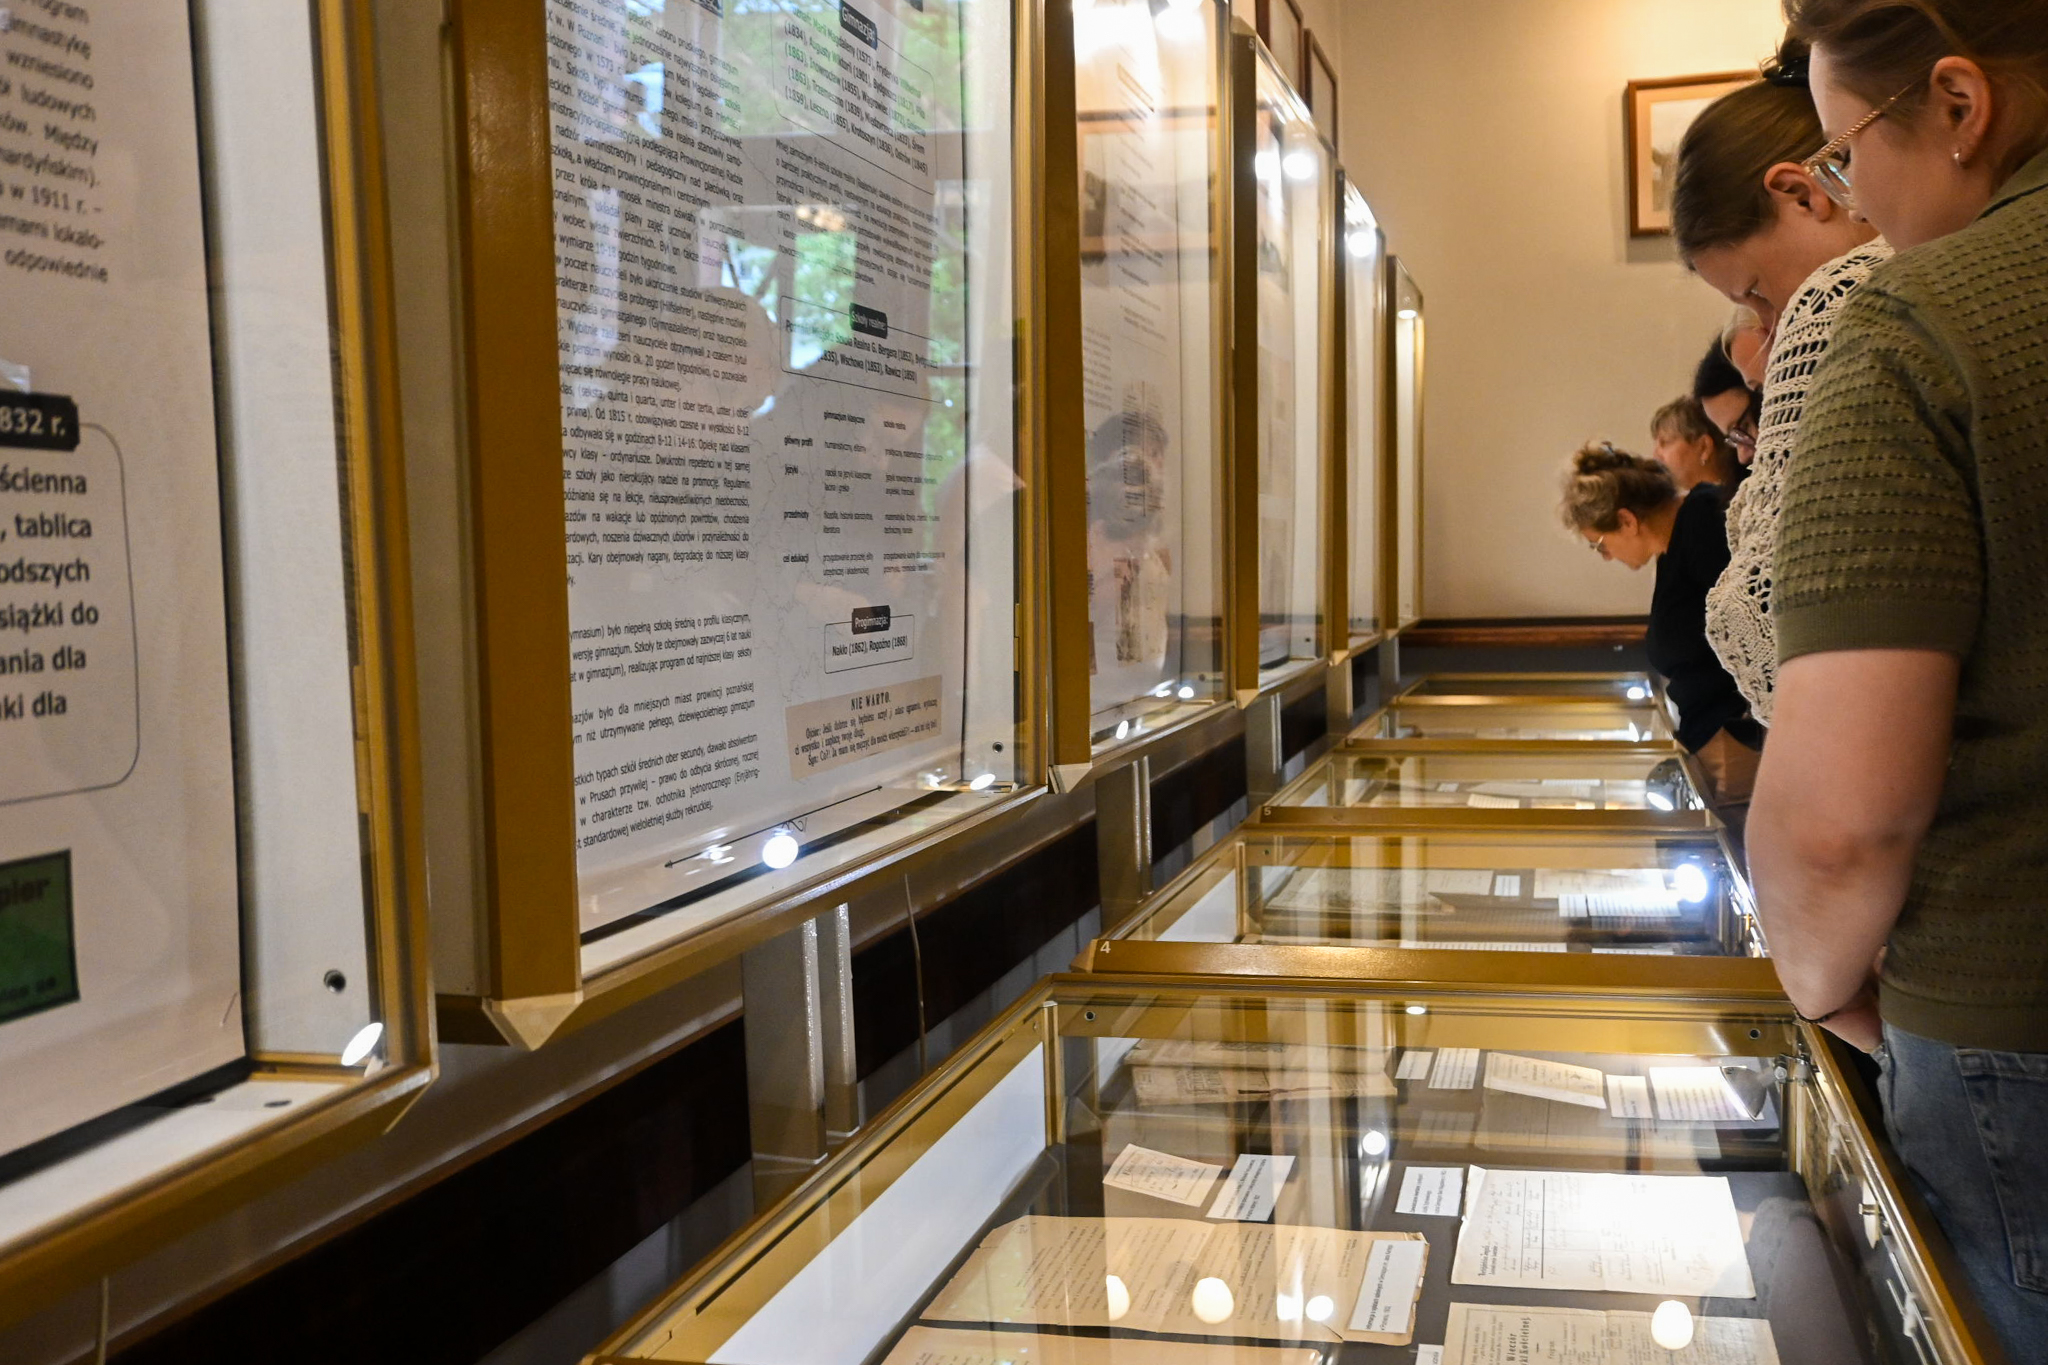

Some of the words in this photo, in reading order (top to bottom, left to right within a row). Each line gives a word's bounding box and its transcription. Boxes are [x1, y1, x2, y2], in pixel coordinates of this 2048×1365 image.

[556, 168, 575, 183] przez
[32, 185, 69, 211] 1911
[608, 389, 628, 403] quinta
[636, 394, 658, 409] quarta,
[661, 397, 676, 409] unter
[50, 416, 66, 438] r.
[566, 404, 592, 420] prima).
[609, 408, 625, 422] 1815
[635, 412, 677, 429] obowiązywało
[570, 425, 603, 441] odbywała
[605, 429, 614, 444] się
[625, 431, 656, 445] godzinach
[658, 434, 672, 446] 8-12
[678, 436, 696, 449] 14-16.
[580, 447, 598, 463] klasy
[611, 450, 652, 465] ordynariusze.
[0, 463, 86, 494] ścienna
[576, 468, 597, 483] szkoły
[601, 469, 615, 484] jako
[619, 470, 654, 486] nierokujący
[599, 490, 609, 504] się
[14, 511, 92, 537] tablica
[606, 510, 631, 525] wakacje
[650, 512, 686, 526] opóźnionych
[603, 531, 630, 543] noszenia
[633, 531, 670, 545] dziwacznych
[672, 531, 694, 542] ubiorów
[588, 552, 603, 566] Kary
[606, 551, 644, 566] obejmowały
[647, 554, 670, 564] nagany,
[71, 600, 98, 625] do
[607, 624, 621, 638] było
[624, 621, 651, 636] niepełną
[675, 617, 696, 630] średnią
[704, 615, 720, 629] profilu
[52, 645, 86, 671] dla
[573, 648, 593, 662] wersję
[595, 644, 632, 661] gimnazjum.
[635, 641, 654, 654] Szkoły
[665, 635, 698, 651] obejmowały
[586, 664, 626, 684] gimnazjum),
[628, 660, 658, 674] realizując
[660, 659, 684, 672] program
[32, 691, 67, 717] dla
[599, 706, 614, 722] było
[634, 696, 670, 713] mniejszych
[675, 692, 692, 705] miast
[697, 687, 722, 704] prowincji
[851, 697, 862, 711] NIE
[586, 729, 596, 742] niż
[600, 720, 644, 740] utrzymywanie
[649, 717, 675, 732] pełnego,
[596, 765, 618, 784] typach
[621, 760, 637, 775] szkół
[639, 754, 664, 771] średnich
[666, 752, 678, 764] ober
[681, 745, 705, 760] secundy,
[590, 785, 616, 803] Prusach
[620, 777, 648, 798] przywilej
[659, 772, 677, 787] prawo
[690, 761, 711, 776] odbycia
[592, 804, 632, 823] charakterze
[638, 799, 651, 810] tzw.
[656, 787, 685, 804] ochotnika
[690, 775, 731, 797] jednorocznego
[583, 822, 629, 847] standardowej
[631, 812, 664, 832] wieloletniej
[666, 807, 683, 822] służby
[1100, 941, 1111, 953] 4
